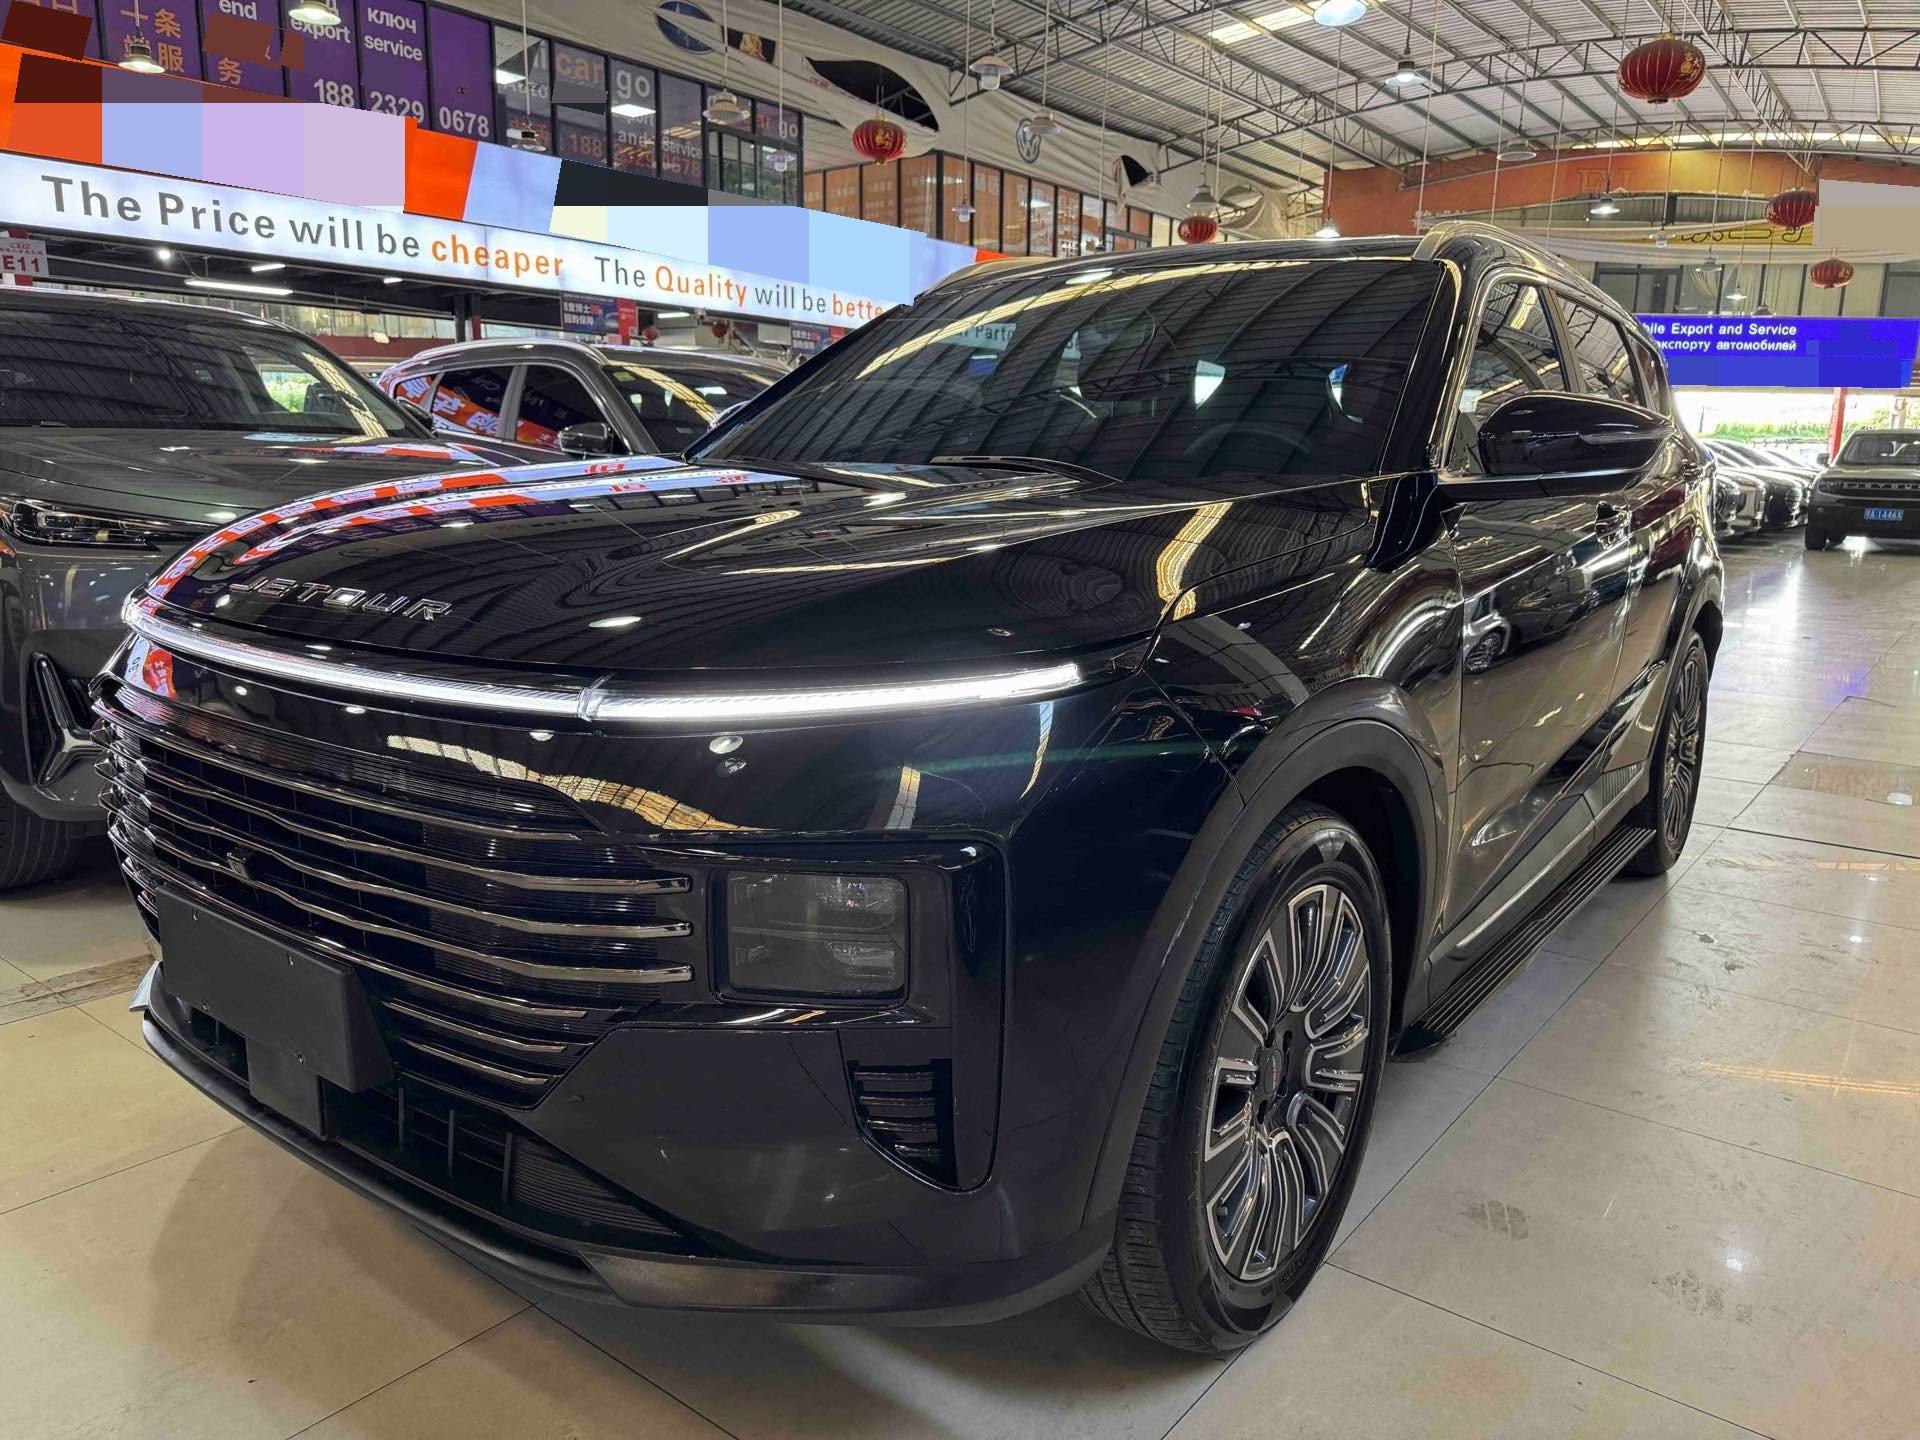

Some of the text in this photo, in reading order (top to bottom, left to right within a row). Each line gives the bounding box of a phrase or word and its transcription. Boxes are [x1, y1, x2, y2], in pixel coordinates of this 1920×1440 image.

[219, 0, 257, 21] end
[367, 7, 416, 34] ключ
[291, 17, 422, 61] export service
[616, 68, 650, 100] go
[313, 78, 354, 109] 188
[369, 91, 424, 124] 2329
[439, 106, 489, 138] 0678
[41, 174, 142, 223] The
[158, 190, 276, 240] Price
[289, 216, 364, 251] will
[376, 224, 421, 258] be
[431, 234, 564, 278] cheaper
[595, 256, 646, 287] The
[655, 265, 747, 307] Quality
[754, 283, 796, 310] will
[802, 288, 827, 313] be
[2, 254, 40, 273] E11
[1672, 322, 1714, 337] Export
[1719, 322, 1743, 336] and
[1749, 322, 1797, 336] Service
[1716, 339, 1797, 352] автомобилей
[229, 576, 452, 620] JETOUR
